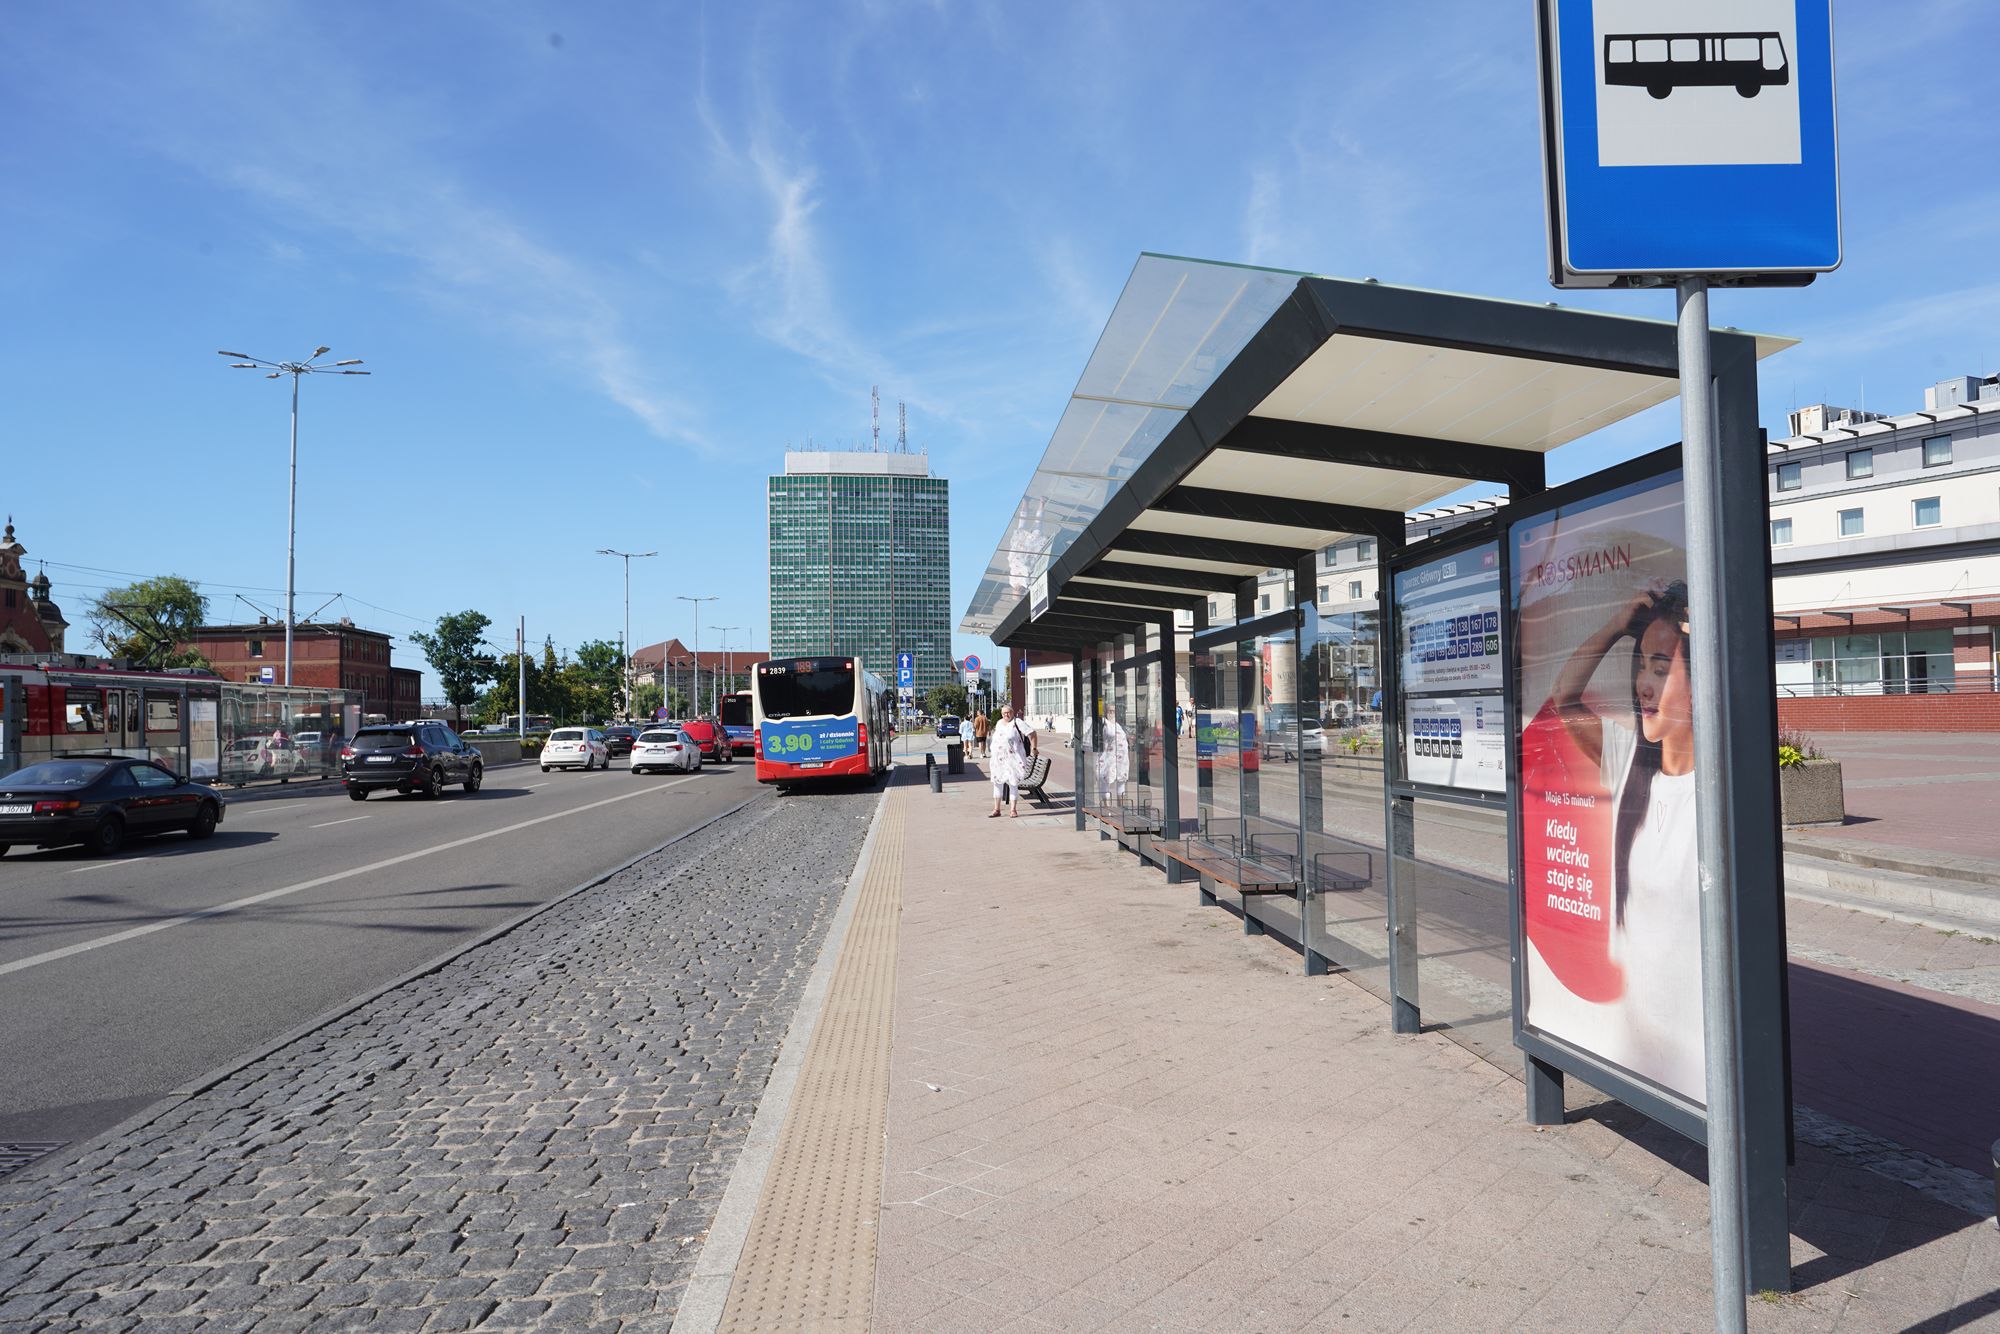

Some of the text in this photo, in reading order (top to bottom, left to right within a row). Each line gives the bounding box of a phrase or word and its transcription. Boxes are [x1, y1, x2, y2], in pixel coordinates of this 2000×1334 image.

[1537, 544, 1630, 587] ROSSMANN
[1421, 568, 1441, 583] Główny
[1458, 620, 1468, 632] 138
[1471, 619, 1481, 630] 167
[1485, 617, 1497, 628] 178
[1459, 643, 1469, 654] 267
[1472, 641, 1483, 653] 289
[1485, 639, 1498, 651] 606
[769, 667, 786, 675] 2839
[901, 670, 910, 682] P
[1451, 723, 1460, 733] 232
[768, 733, 813, 755] 3,90
[1545, 791, 1595, 808] Moje 15 minut?
[1546, 818, 1577, 846] Kiedy
[1546, 844, 1589, 869] wcierka
[1546, 869, 1593, 900] staje się
[1547, 893, 1601, 921] masażem
